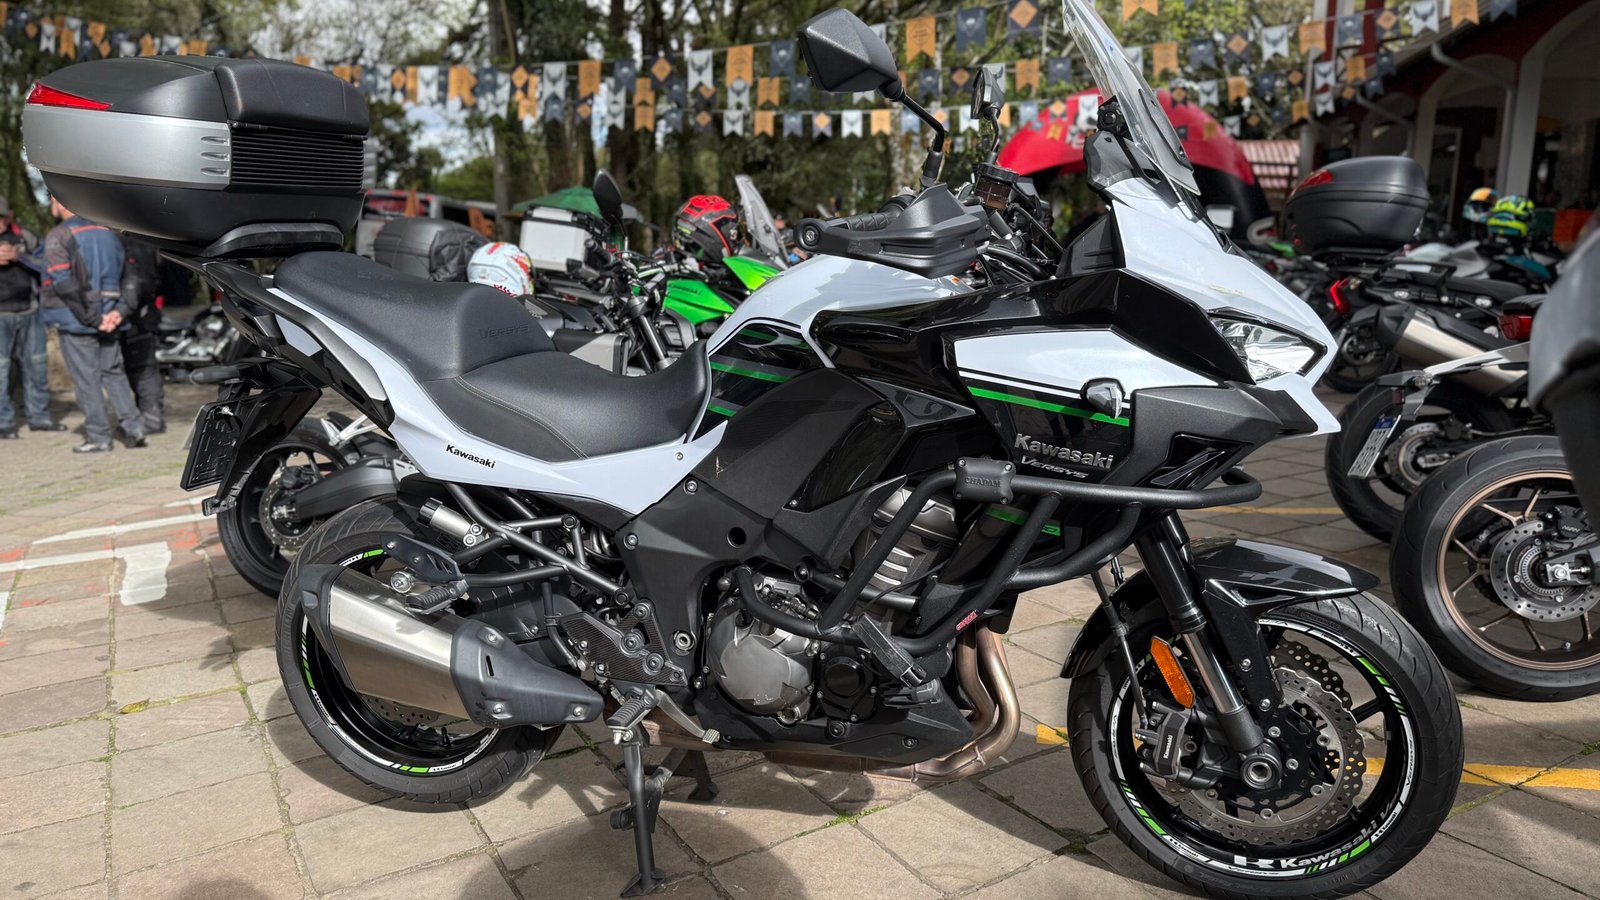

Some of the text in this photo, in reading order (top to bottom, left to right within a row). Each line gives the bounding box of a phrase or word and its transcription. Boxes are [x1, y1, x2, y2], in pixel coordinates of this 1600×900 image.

[446, 444, 496, 469] Kawasaki
[1014, 433, 1114, 469] Kawasaki
[1021, 455, 1089, 479] VERSYS
[1280, 820, 1378, 869] Kawasaki
